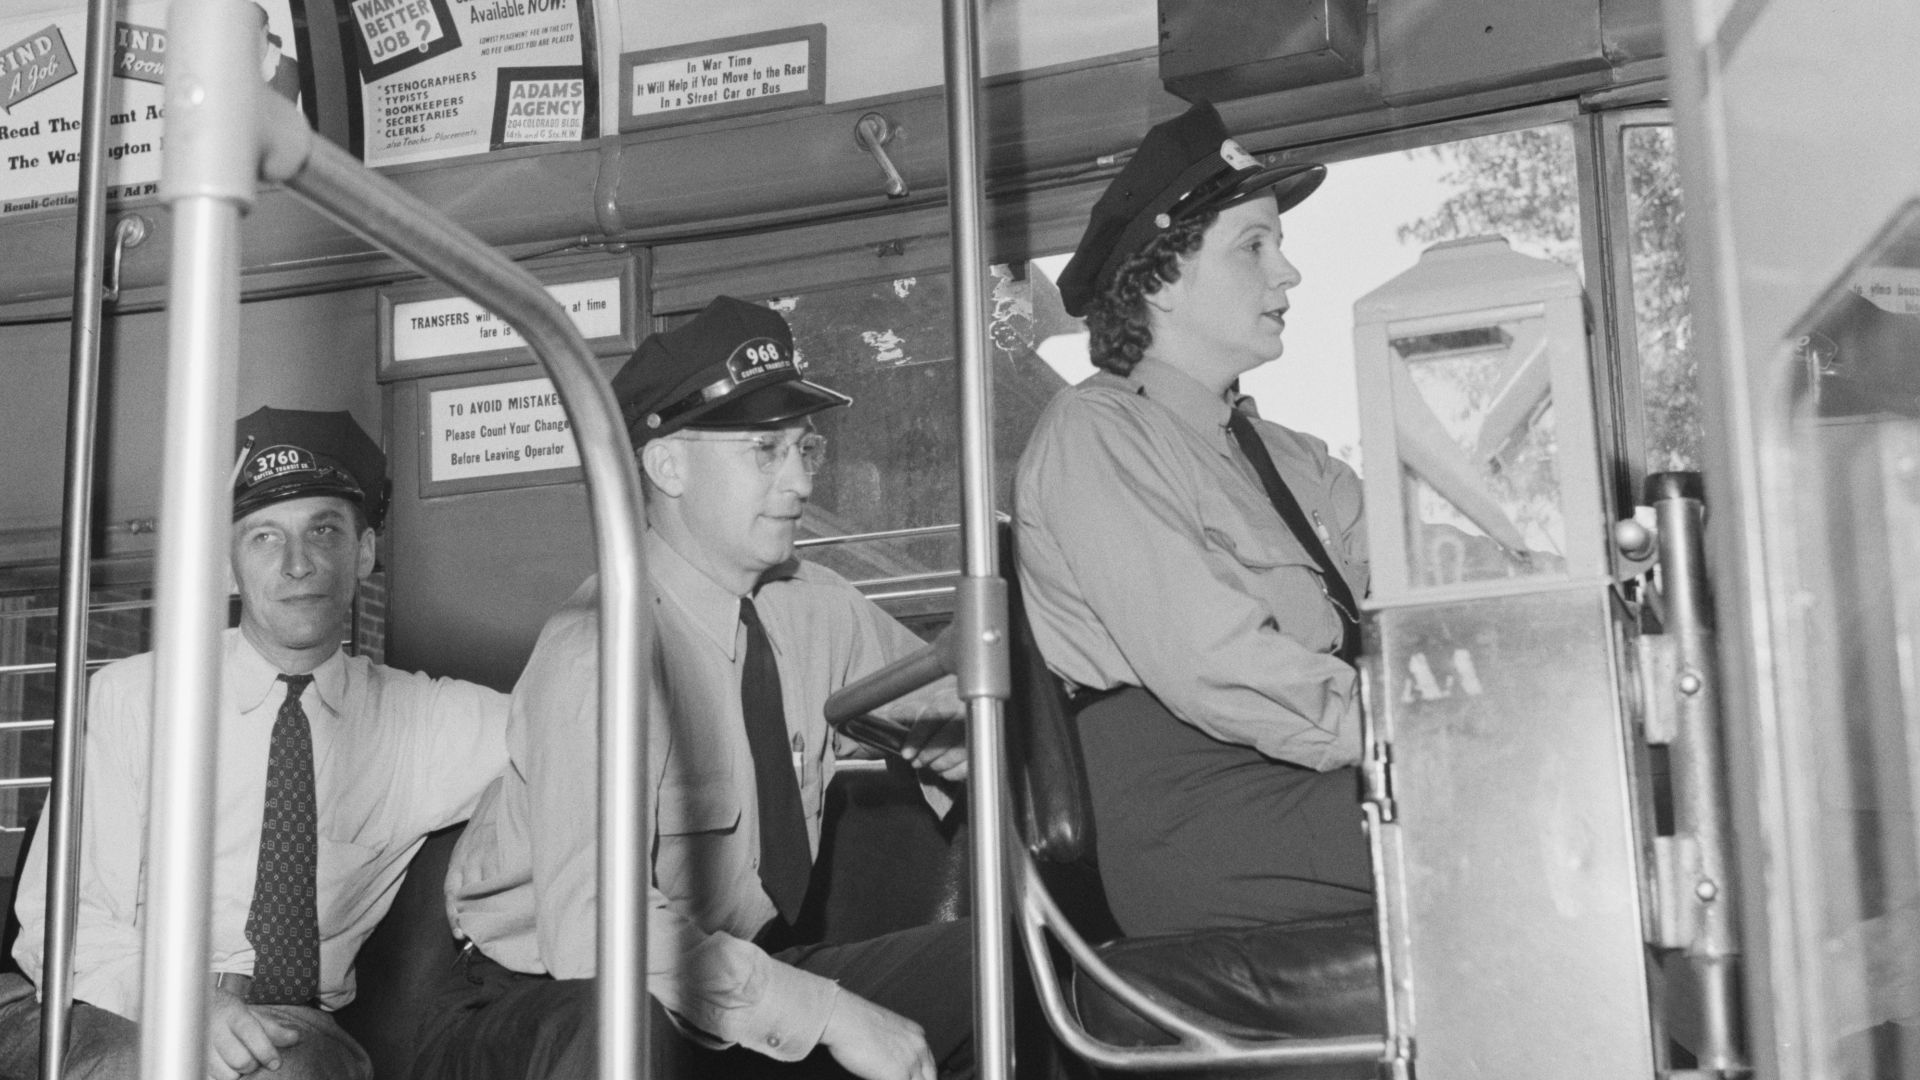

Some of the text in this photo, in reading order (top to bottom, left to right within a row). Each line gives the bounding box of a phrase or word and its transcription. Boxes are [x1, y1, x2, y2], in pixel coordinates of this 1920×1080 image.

[357, 0, 403, 20] WAN
[365, 0, 430, 39] BETTER
[470, 0, 525, 24] Available
[119, 28, 165, 52] IND
[374, 19, 431, 57] JOB ?
[530, 27, 540, 37] FEE
[542, 26, 548, 34] IN
[549, 25, 560, 33] THE
[560, 23, 573, 32] CITY
[481, 34, 575, 56] NO FEE UNLESS YOU ARE PLACED
[687, 54, 752, 74] In War Time
[9, 55, 58, 99] A Job
[384, 71, 477, 95] STENOGRAPHERS
[637, 63, 806, 96] It Will Help if You Move to the Rear
[385, 91, 429, 105] TYPISTS
[512, 82, 582, 99] ADAMS
[660, 82, 781, 109] In a Street Car or Bus
[385, 96, 464, 117] BOOKKEEPERS
[386, 107, 459, 127] SECRETARIES
[510, 100, 582, 116] AGENCY
[0, 120, 40, 140] Read
[48, 118, 81, 134] The
[110, 110, 136, 125] ant
[385, 124, 425, 138] CLERKS
[507, 119, 522, 129] 204
[523, 118, 559, 128] COLORADO
[403, 135, 432, 147] Teacher
[434, 129, 477, 142] Placements
[8, 155, 39, 170] The
[4, 194, 78, 213] Result-Gettin
[124, 185, 141, 198] Ad
[411, 311, 470, 330] TRANSFERS
[475, 311, 491, 323] will
[573, 301, 581, 313] at
[587, 299, 607, 312] time
[480, 326, 497, 338] fare
[503, 324, 511, 336] is
[747, 344, 778, 364] 968
[449, 403, 463, 417] TO
[470, 399, 502, 415] AVOID
[445, 418, 570, 442] Please Count Your Change
[257, 450, 298, 472] 3760
[451, 443, 564, 466] Before Leaving Operator
